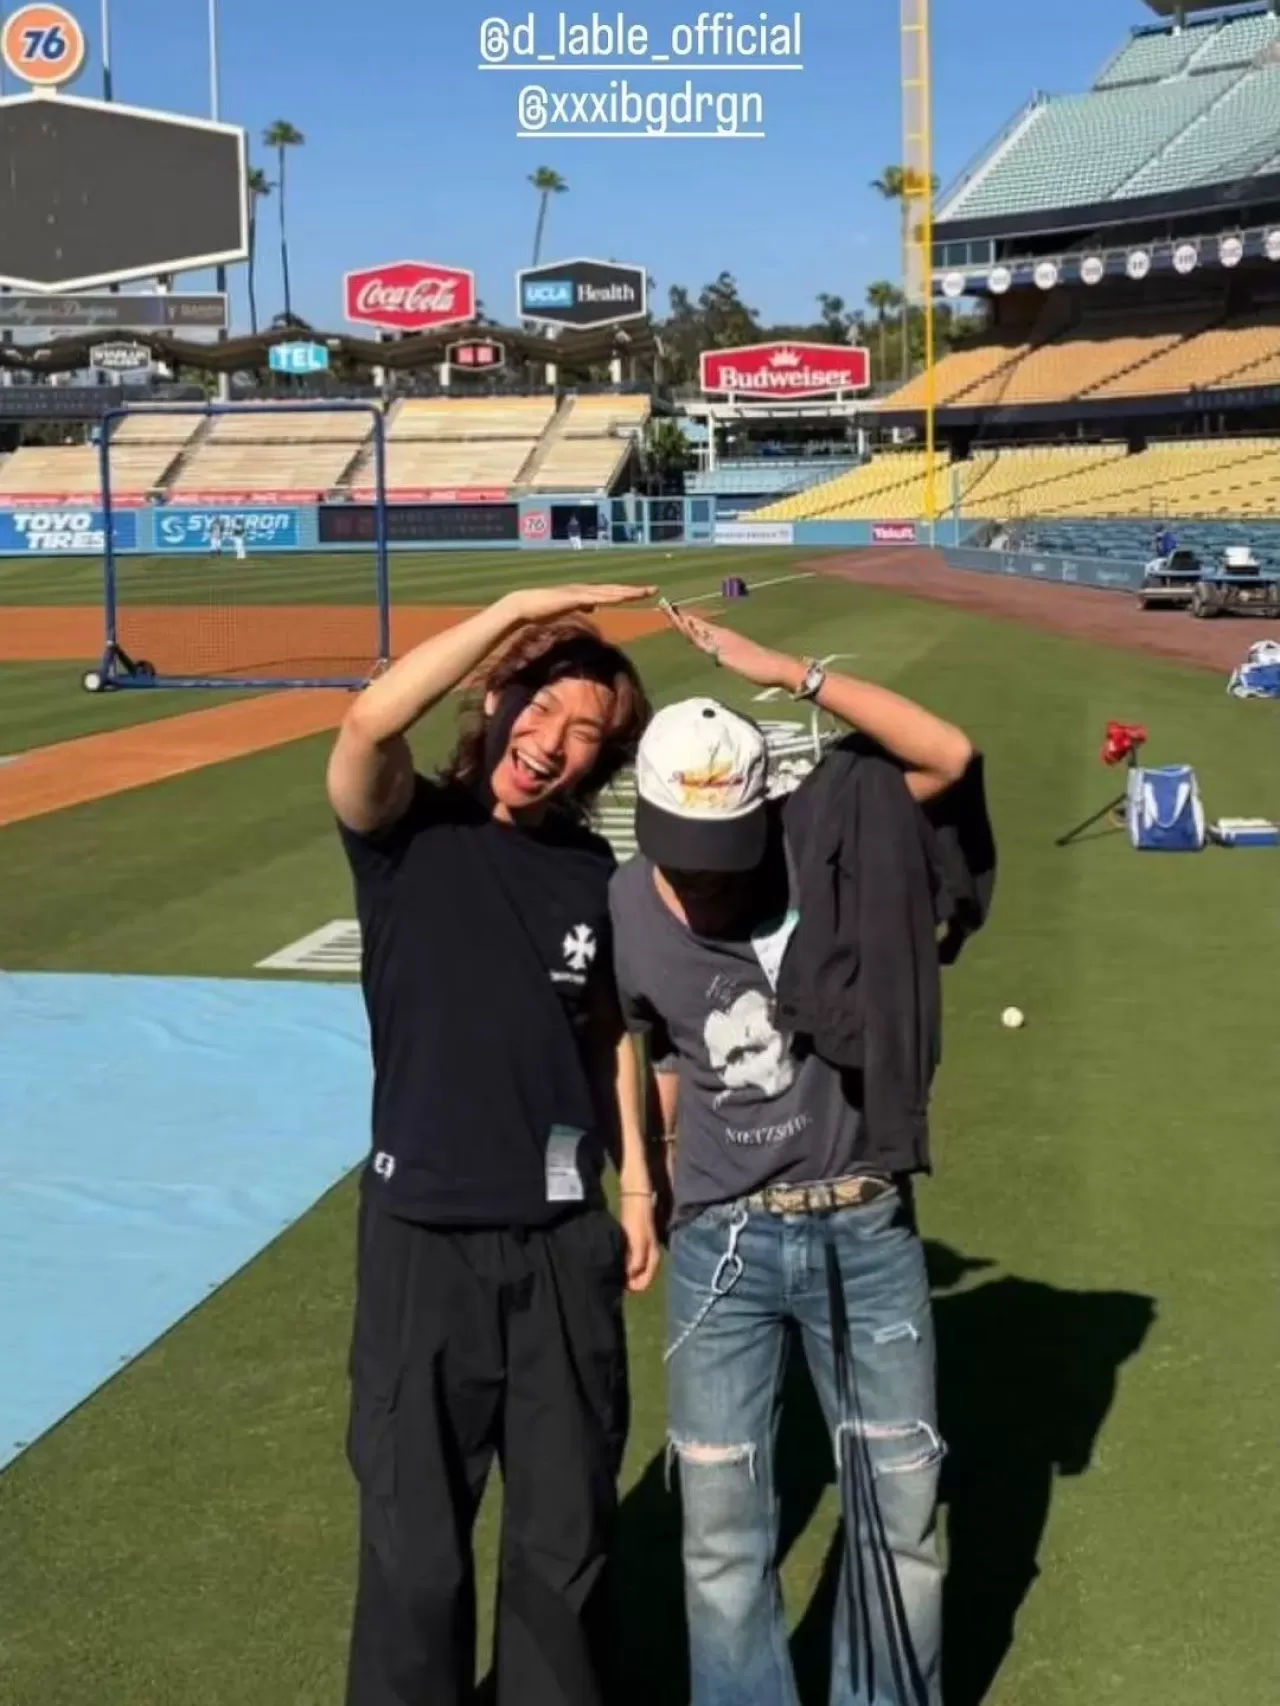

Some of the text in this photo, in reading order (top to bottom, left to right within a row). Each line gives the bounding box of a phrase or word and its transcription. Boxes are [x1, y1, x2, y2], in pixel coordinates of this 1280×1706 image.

[22, 25, 67, 60] 76
[526, 283, 635, 302] UCLA Health
[719, 365, 853, 388] Budweiser
[13, 512, 91, 532] TOYO
